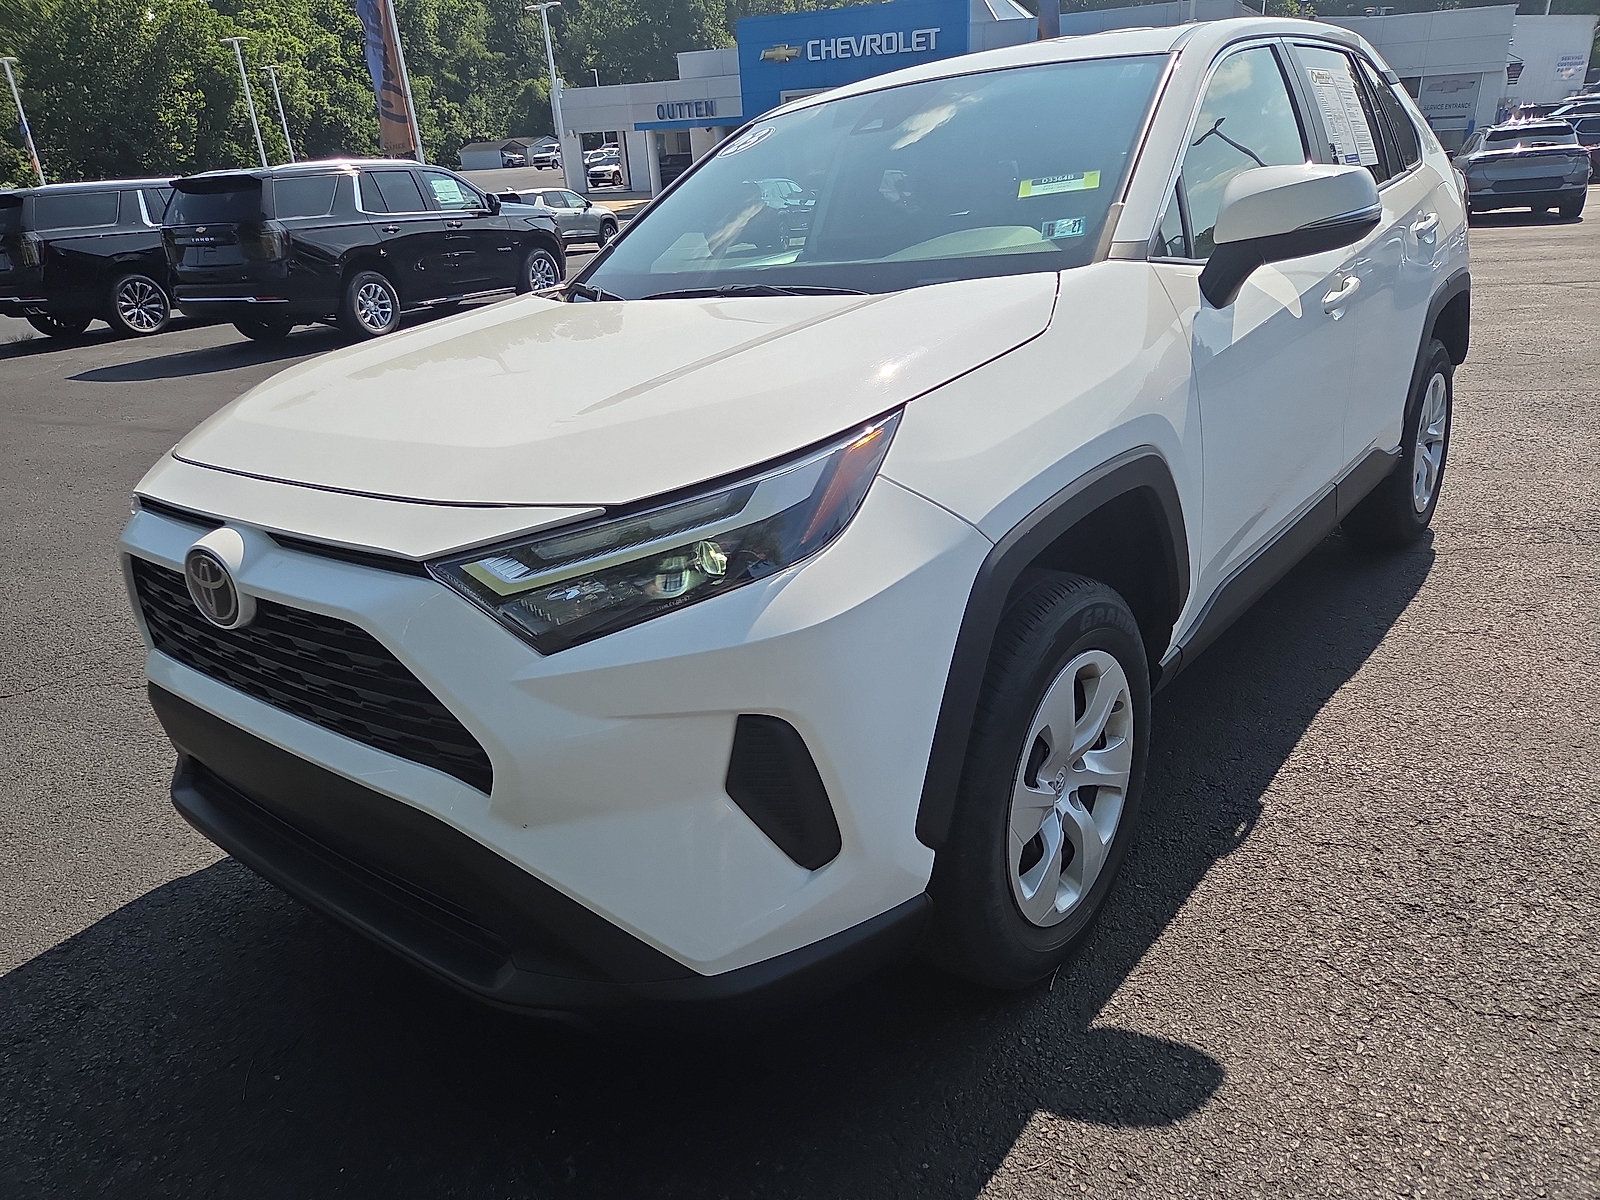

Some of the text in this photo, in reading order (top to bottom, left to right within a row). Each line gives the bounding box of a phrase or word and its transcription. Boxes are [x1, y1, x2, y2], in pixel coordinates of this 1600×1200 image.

[807, 28, 940, 61] CHEVROLET
[656, 100, 716, 121] OUTTEN
[1071, 219, 1082, 233] 27
